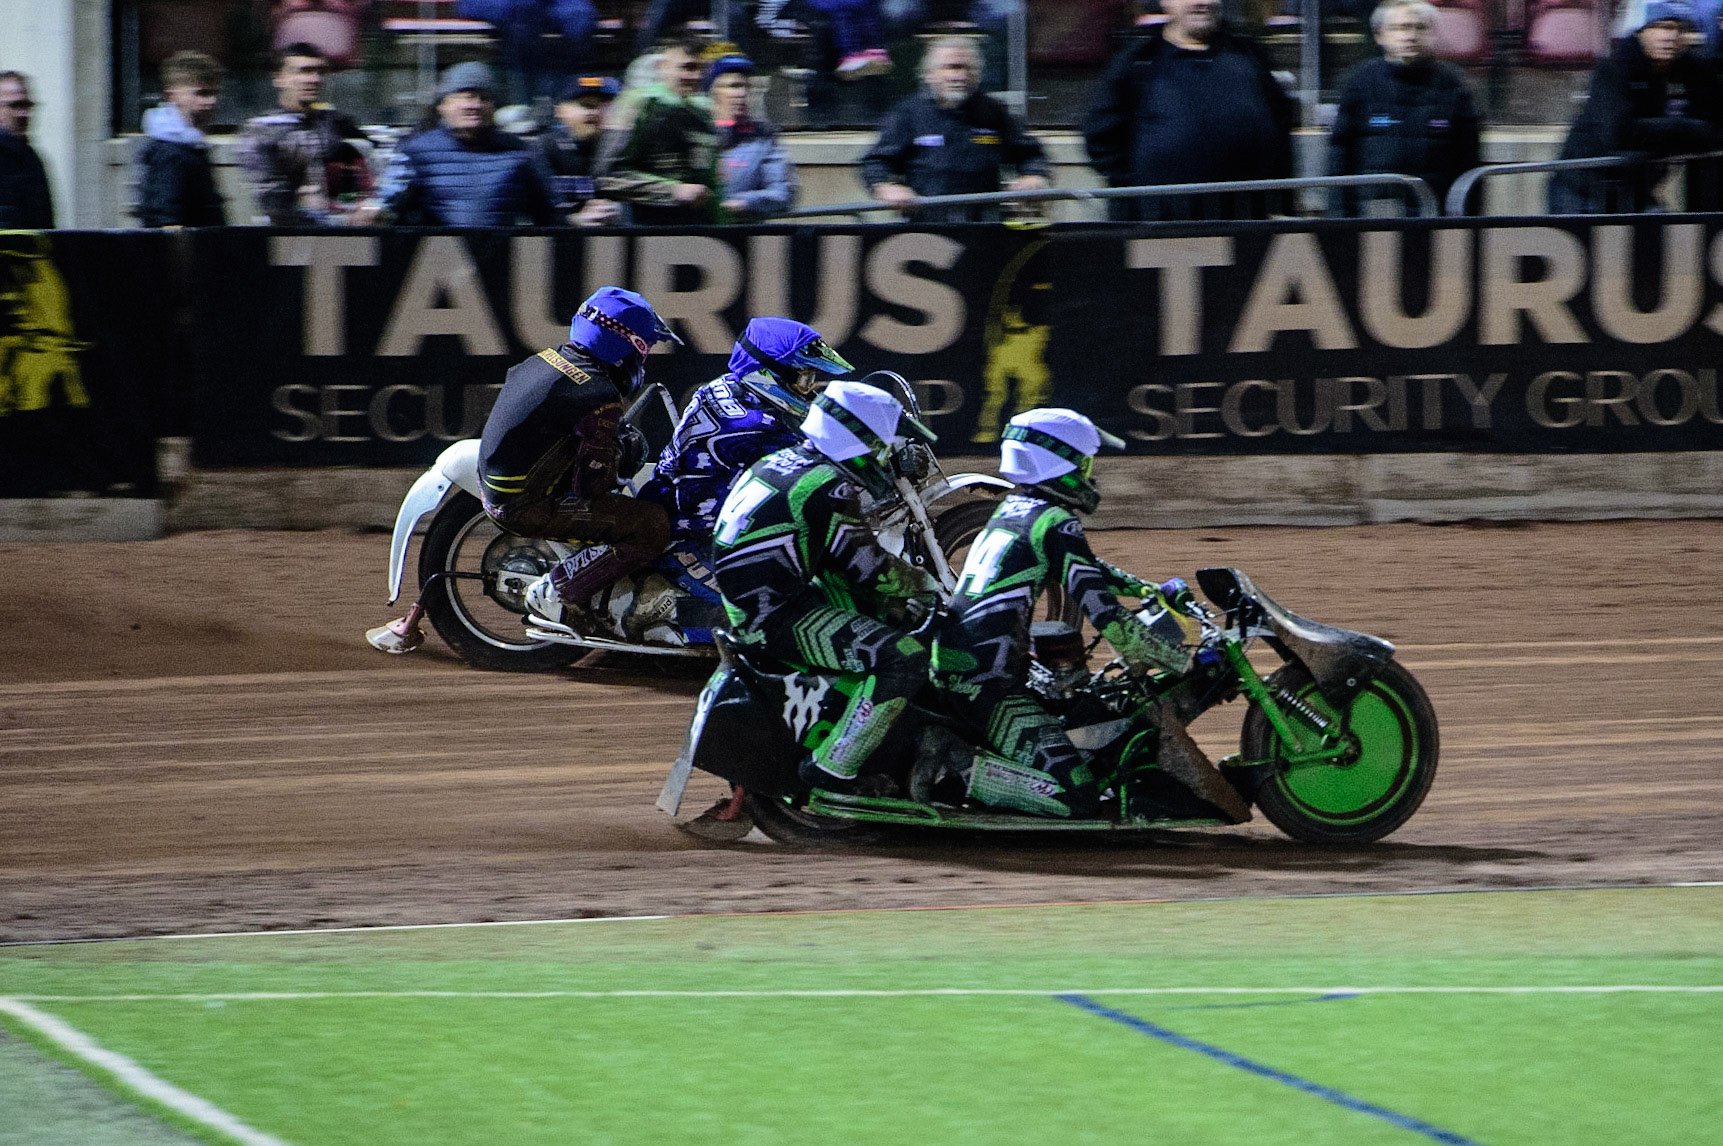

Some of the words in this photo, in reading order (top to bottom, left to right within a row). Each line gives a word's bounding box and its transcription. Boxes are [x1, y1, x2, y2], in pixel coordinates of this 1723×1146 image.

[268, 233, 967, 357] TAURUS
[1126, 224, 1723, 355] TAURU
[1127, 372, 1508, 440] SECURITY
